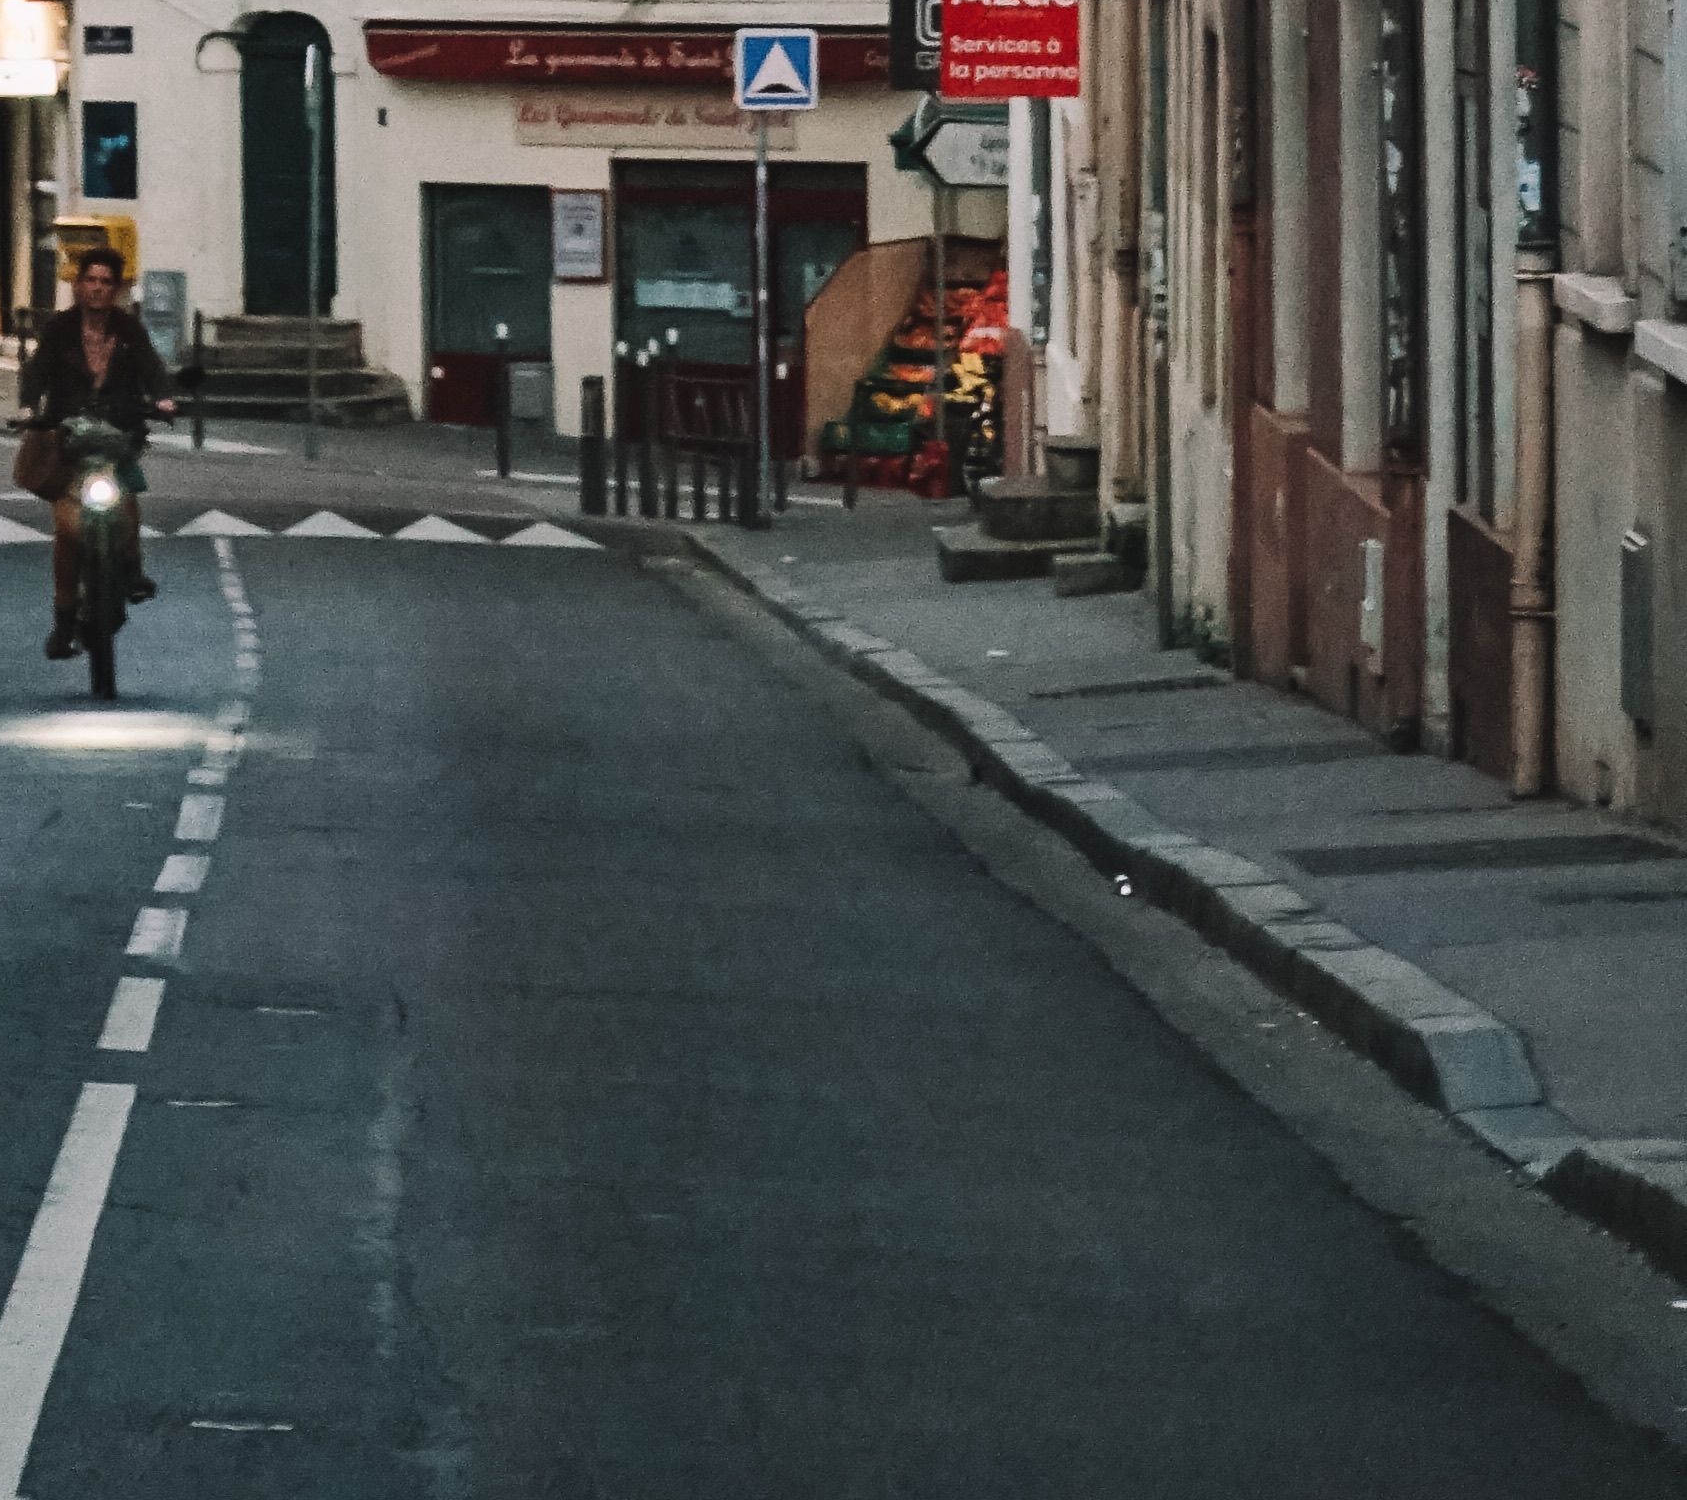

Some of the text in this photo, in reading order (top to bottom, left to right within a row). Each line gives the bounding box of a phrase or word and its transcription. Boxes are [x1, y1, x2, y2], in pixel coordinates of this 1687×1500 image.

[950, 35, 1061, 54] Services à
[949, 61, 1079, 84] la personne
